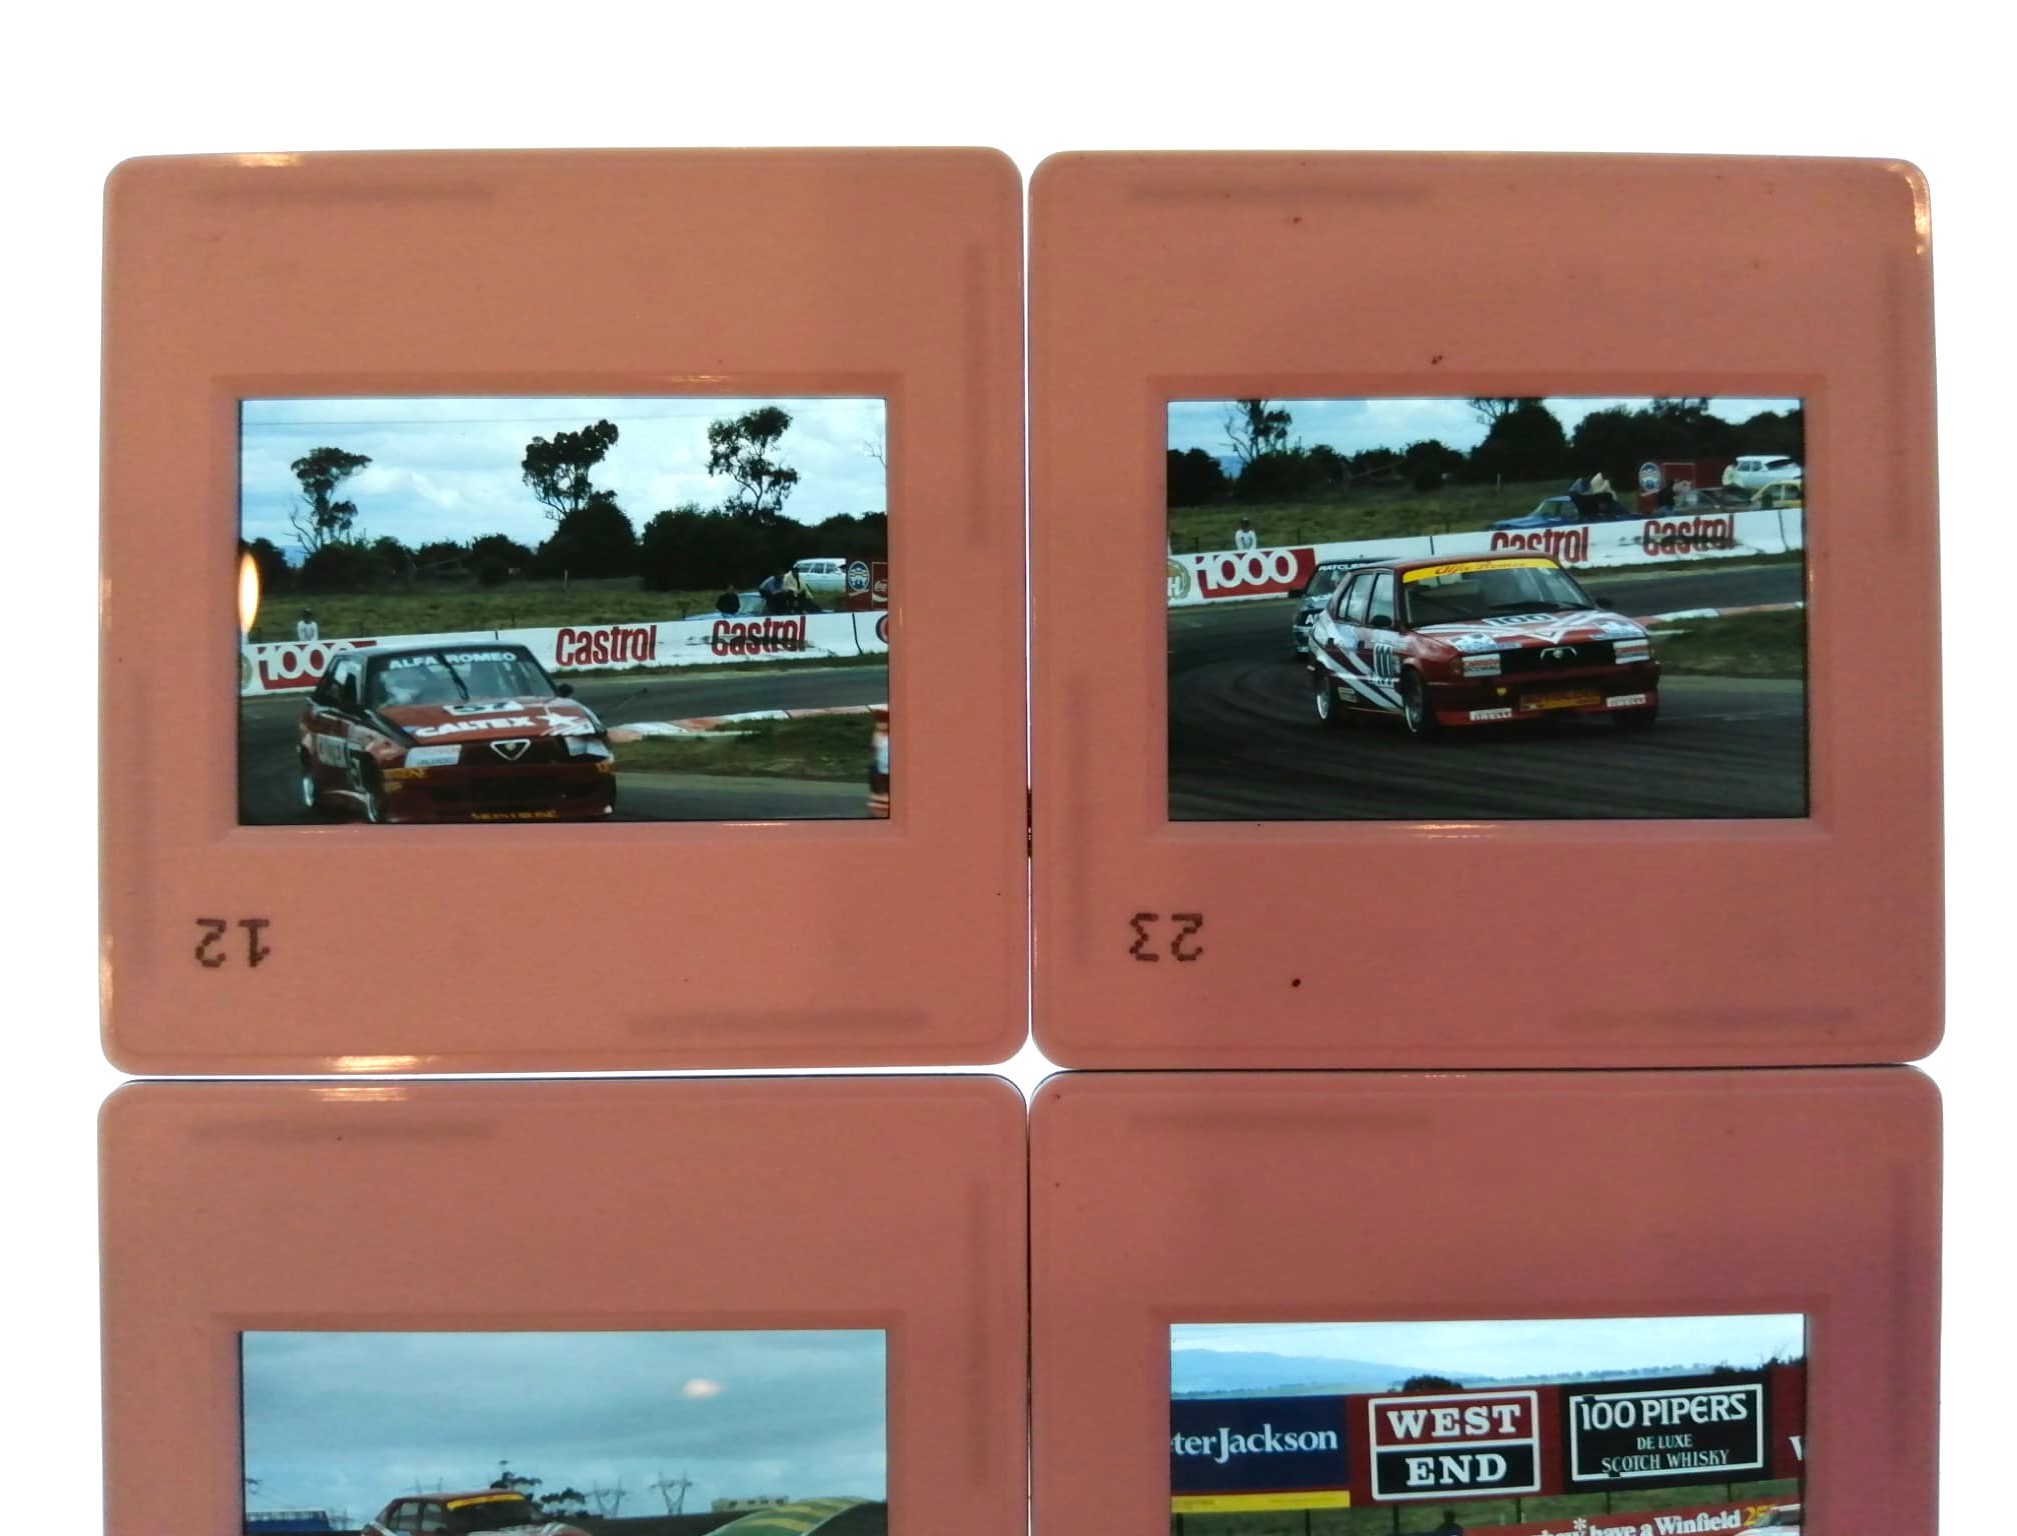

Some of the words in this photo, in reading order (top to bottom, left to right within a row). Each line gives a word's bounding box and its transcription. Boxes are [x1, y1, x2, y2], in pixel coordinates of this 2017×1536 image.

[1642, 514, 1734, 556] Castrol
[1195, 550, 1298, 590] 1000
[555, 625, 657, 667] Castrol
[711, 615, 806, 657] Castrol
[389, 656, 439, 669] ALFA
[444, 652, 517, 665] ROMEO
[415, 717, 536, 737] CALTEX
[195, 918, 271, 968] 12
[1129, 913, 1203, 962] 23
[1387, 1404, 1521, 1439] WEST
[1581, 1401, 1636, 1430] 100
[1641, 1393, 1748, 1426] PIPERS
[1636, 1436, 1655, 1450] DE
[1658, 1434, 1693, 1449] LUXE
[1405, 1453, 1508, 1486] END
[1601, 1454, 1661, 1473] SCOTCH
[1666, 1450, 1729, 1468] WHISKY
[1654, 1509, 1741, 1535] Winfield
